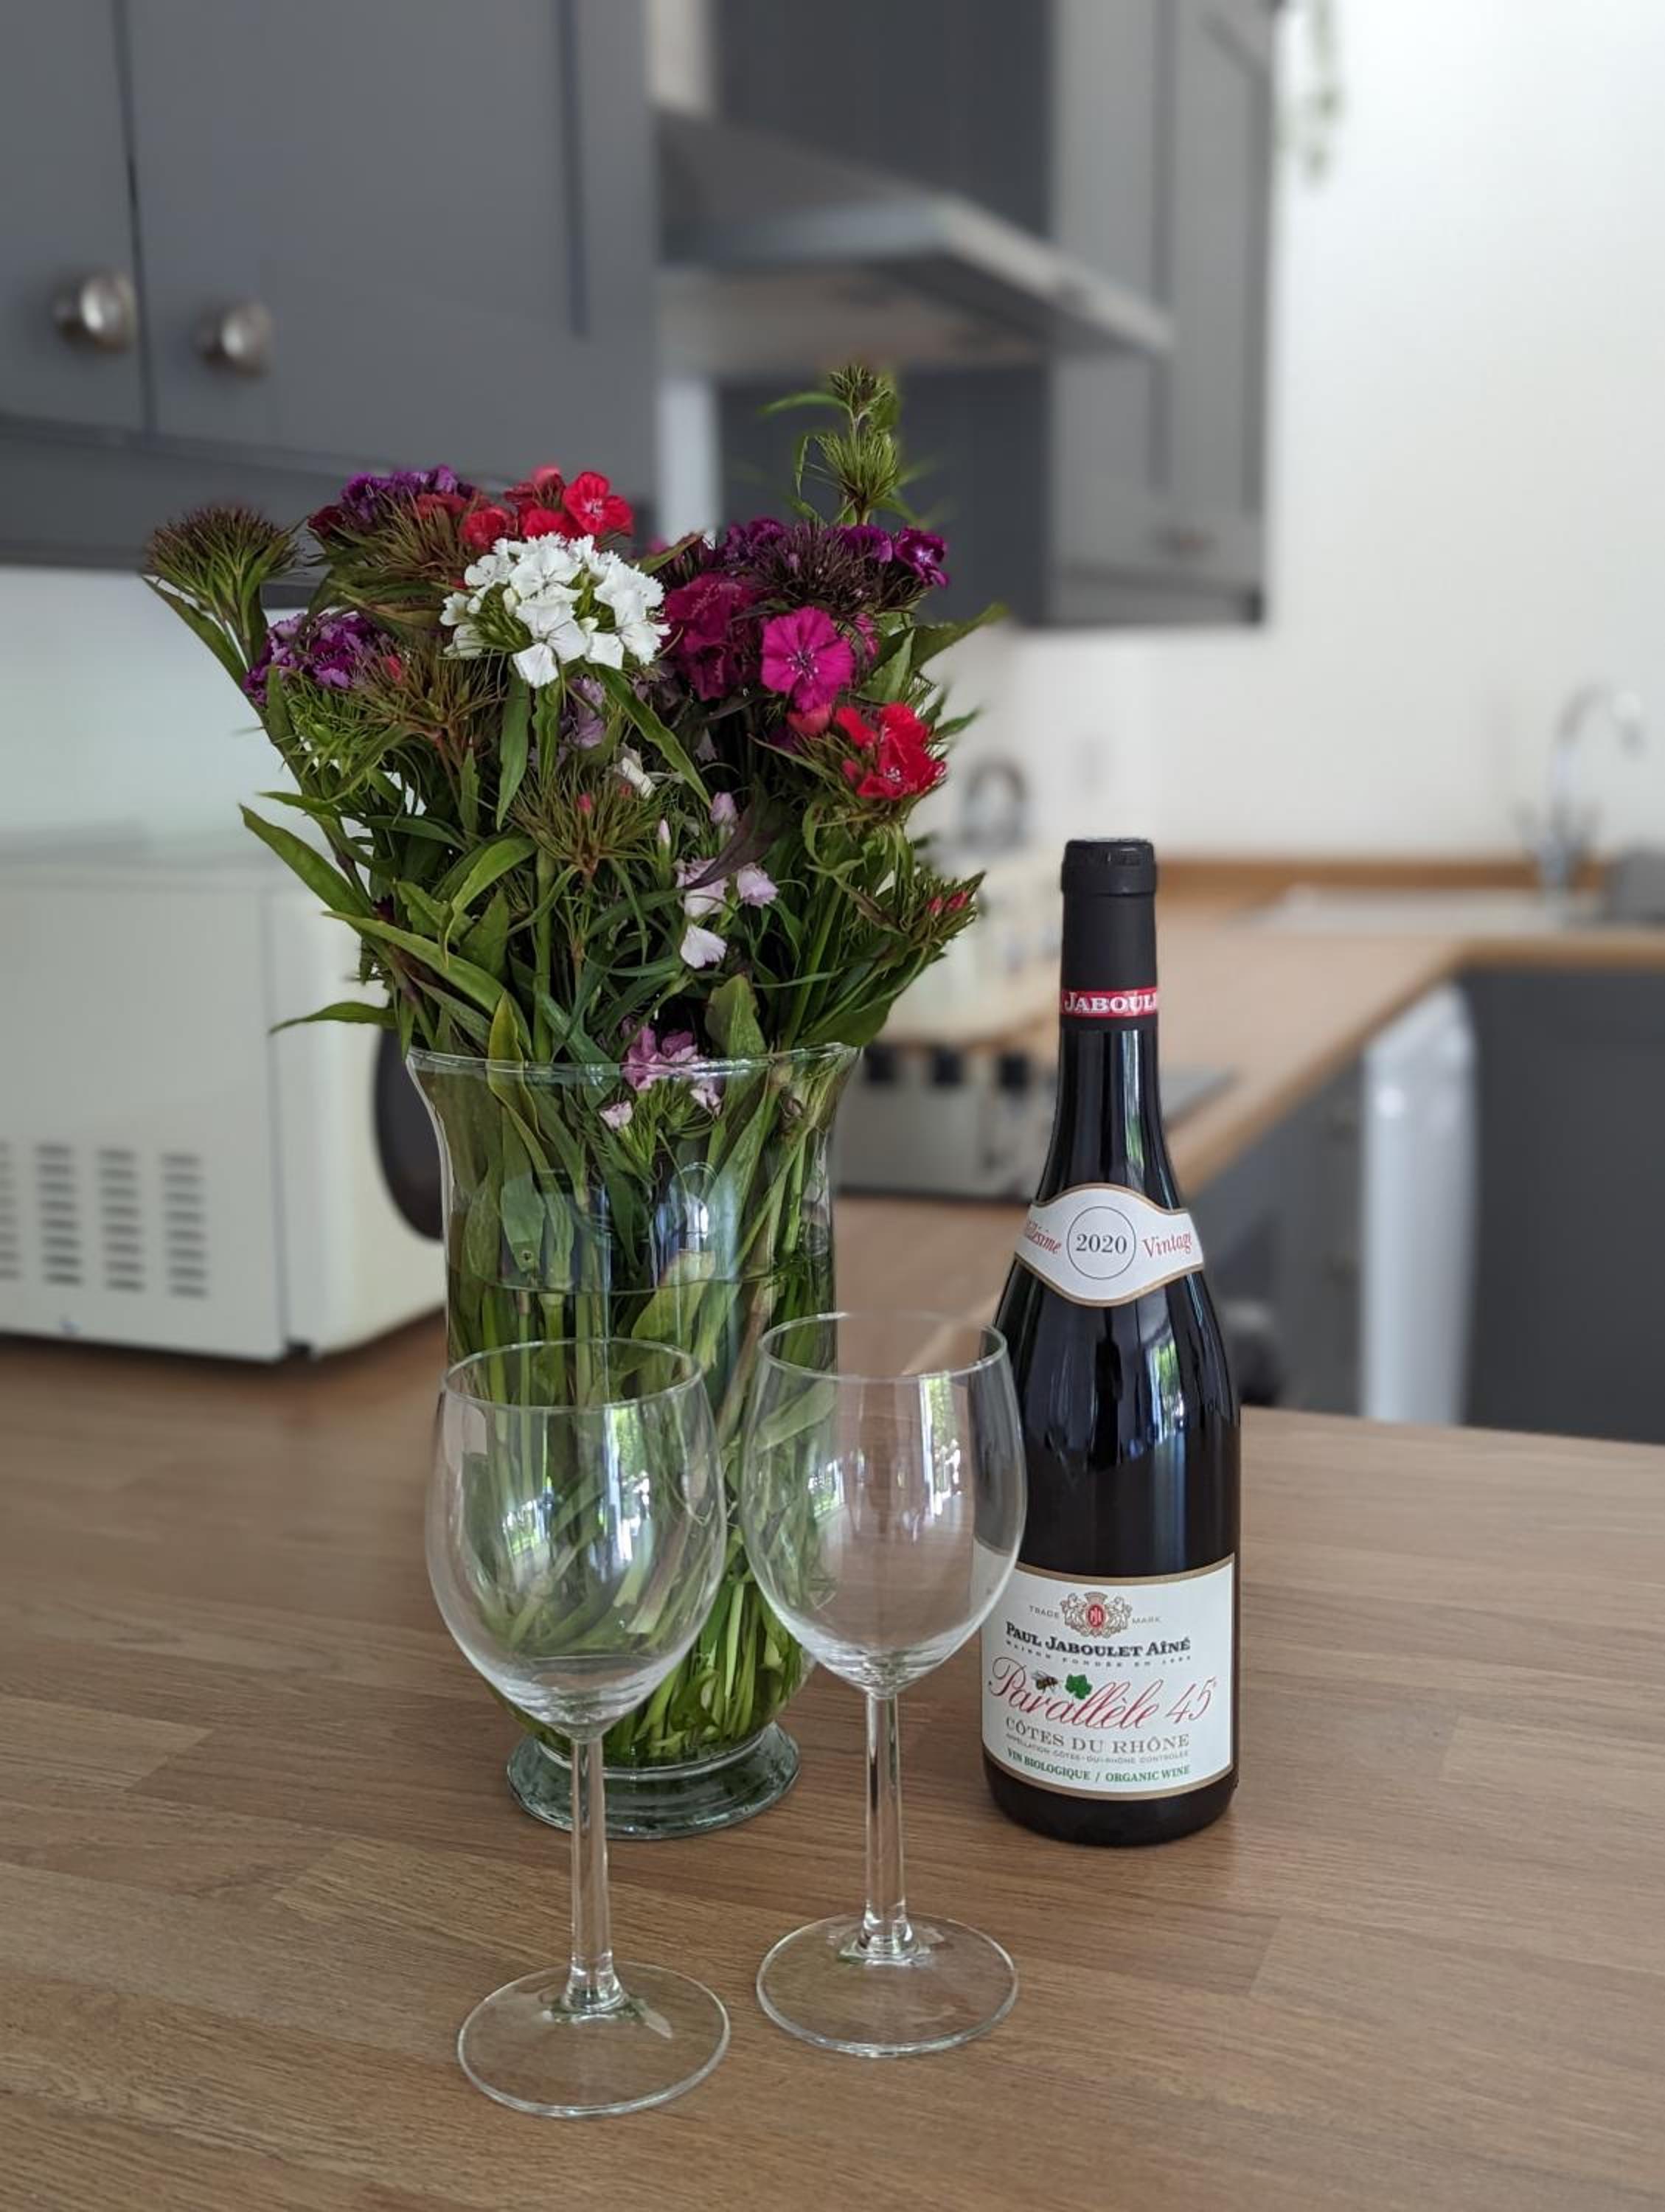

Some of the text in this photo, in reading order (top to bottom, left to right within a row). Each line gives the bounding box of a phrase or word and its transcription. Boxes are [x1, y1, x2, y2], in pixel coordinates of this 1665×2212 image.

[1064, 991, 1156, 1013] JABOUL
[1076, 1233, 1127, 1253] 2020
[1006, 1621, 1042, 1647] PAUL
[1045, 1635, 1143, 1658] JABOULET
[988, 1657, 1216, 1729] Parallèle 45
[1006, 1716, 1065, 1747] CÔTES
[1072, 1736, 1104, 1753] DU
[1112, 1733, 1190, 1754] RHÔNE
[1007, 1747, 1023, 1761] VIN
[1023, 1756, 1091, 1781] BIOLOGIQUE
[1105, 1770, 1160, 1783] ORGANIC
[1161, 1764, 1191, 1779] WINE
